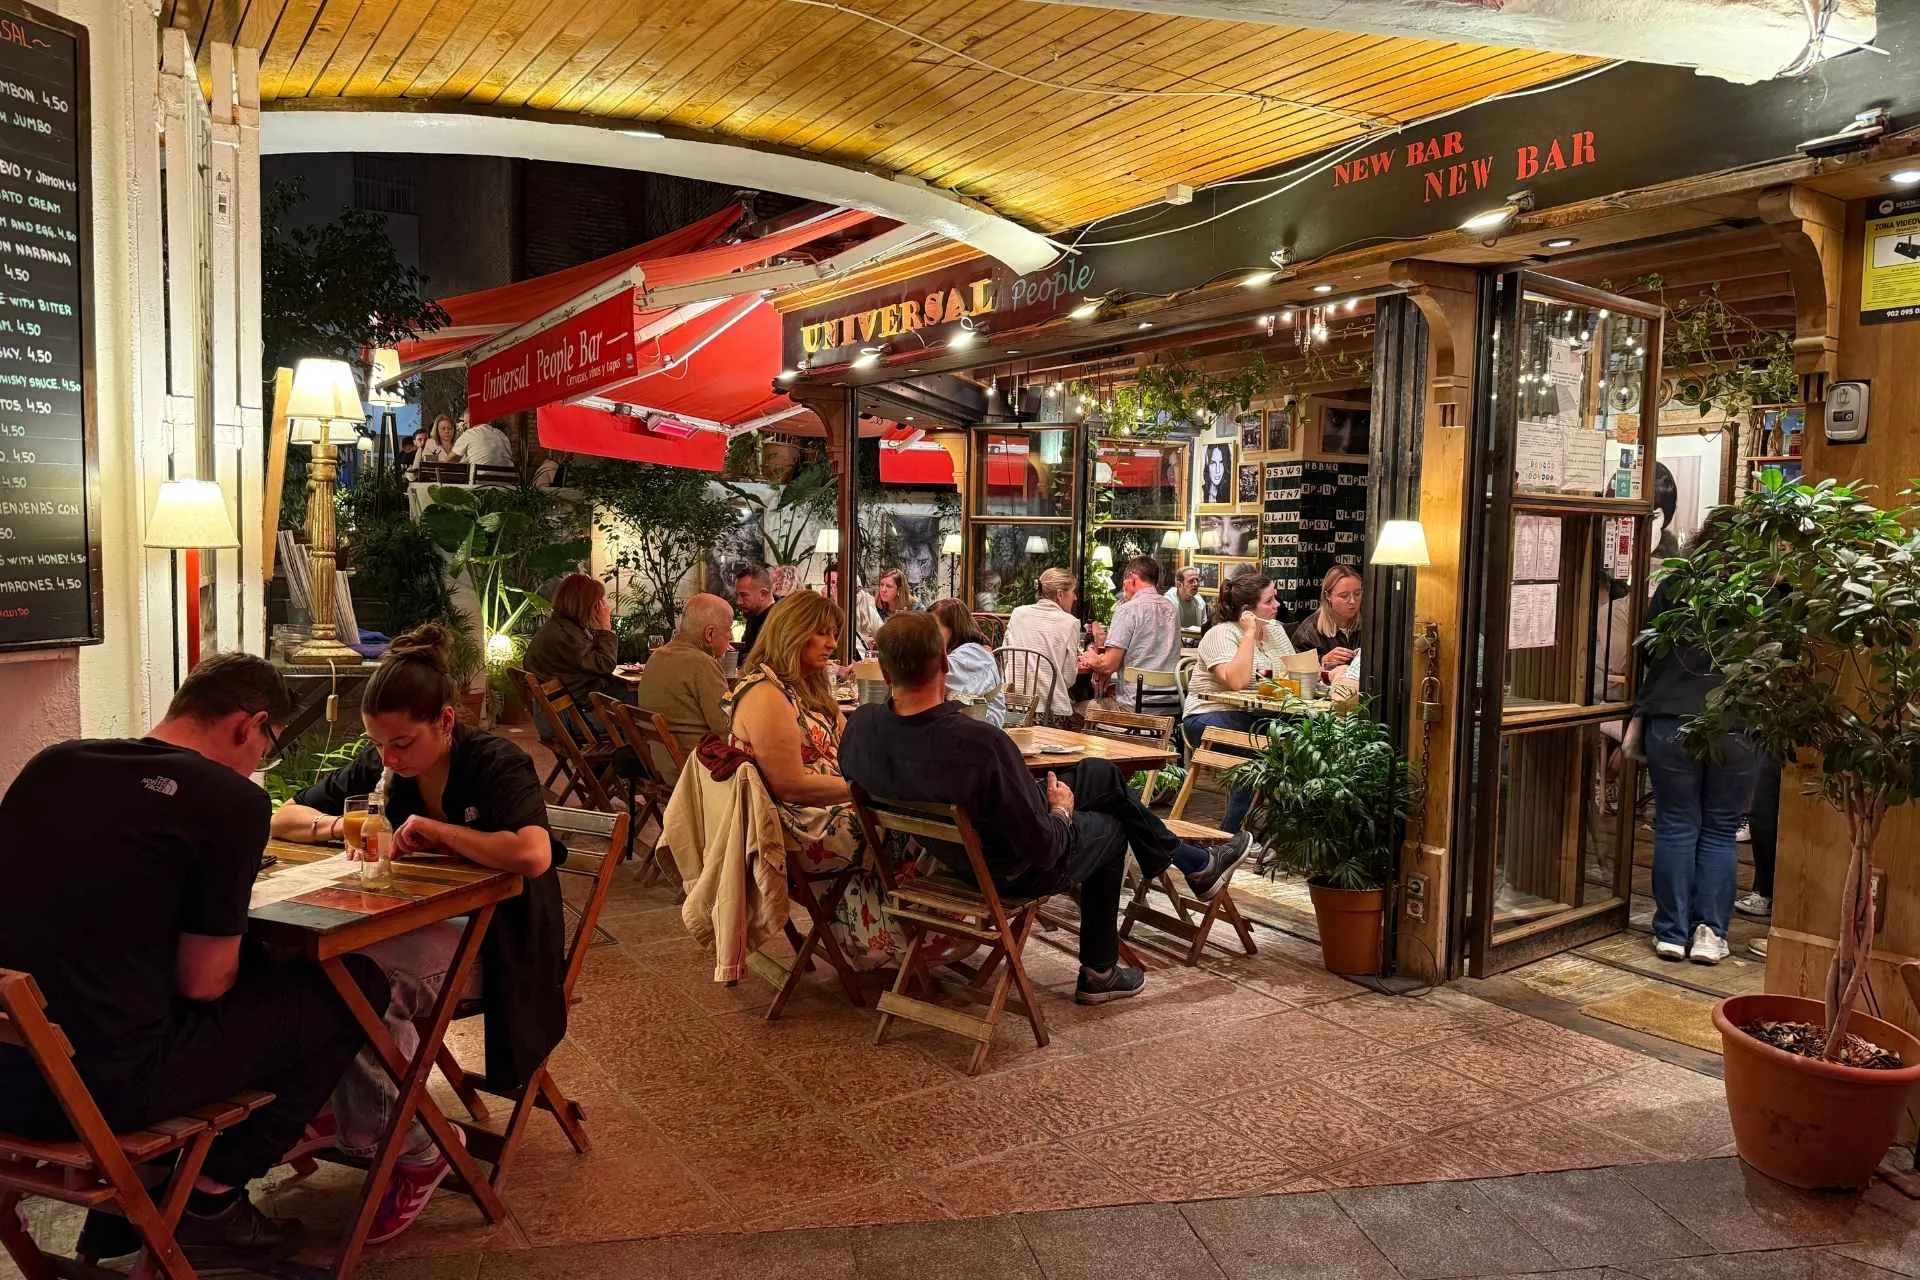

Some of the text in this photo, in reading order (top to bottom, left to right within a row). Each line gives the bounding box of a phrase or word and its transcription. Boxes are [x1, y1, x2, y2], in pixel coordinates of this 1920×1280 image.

[42, 90, 69, 113] 4.50
[13, 112, 52, 135] JUMBO
[1332, 131, 1464, 187] NEW BAR
[1423, 130, 1599, 203] NEW BAR
[24, 167, 32, 180] Y
[28, 196, 61, 214] CREAM
[11, 218, 33, 232] AND
[15, 243, 72, 267] NARANJA
[4, 264, 30, 282] 4.50
[37, 298, 73, 317] BITTER
[801, 258, 1096, 352] UNIVERSAL People
[17, 319, 42, 336] 4.50
[27, 345, 53, 364] 4.50
[482, 330, 603, 402] Universal People Bar
[26, 397, 52, 414] 4.50
[1, 423, 26, 437] 4.50
[13, 448, 36, 464] 4.50
[2, 475, 27, 489] 4.50
[57, 503, 79, 515] CON
[56, 576, 82, 591] 4.50
